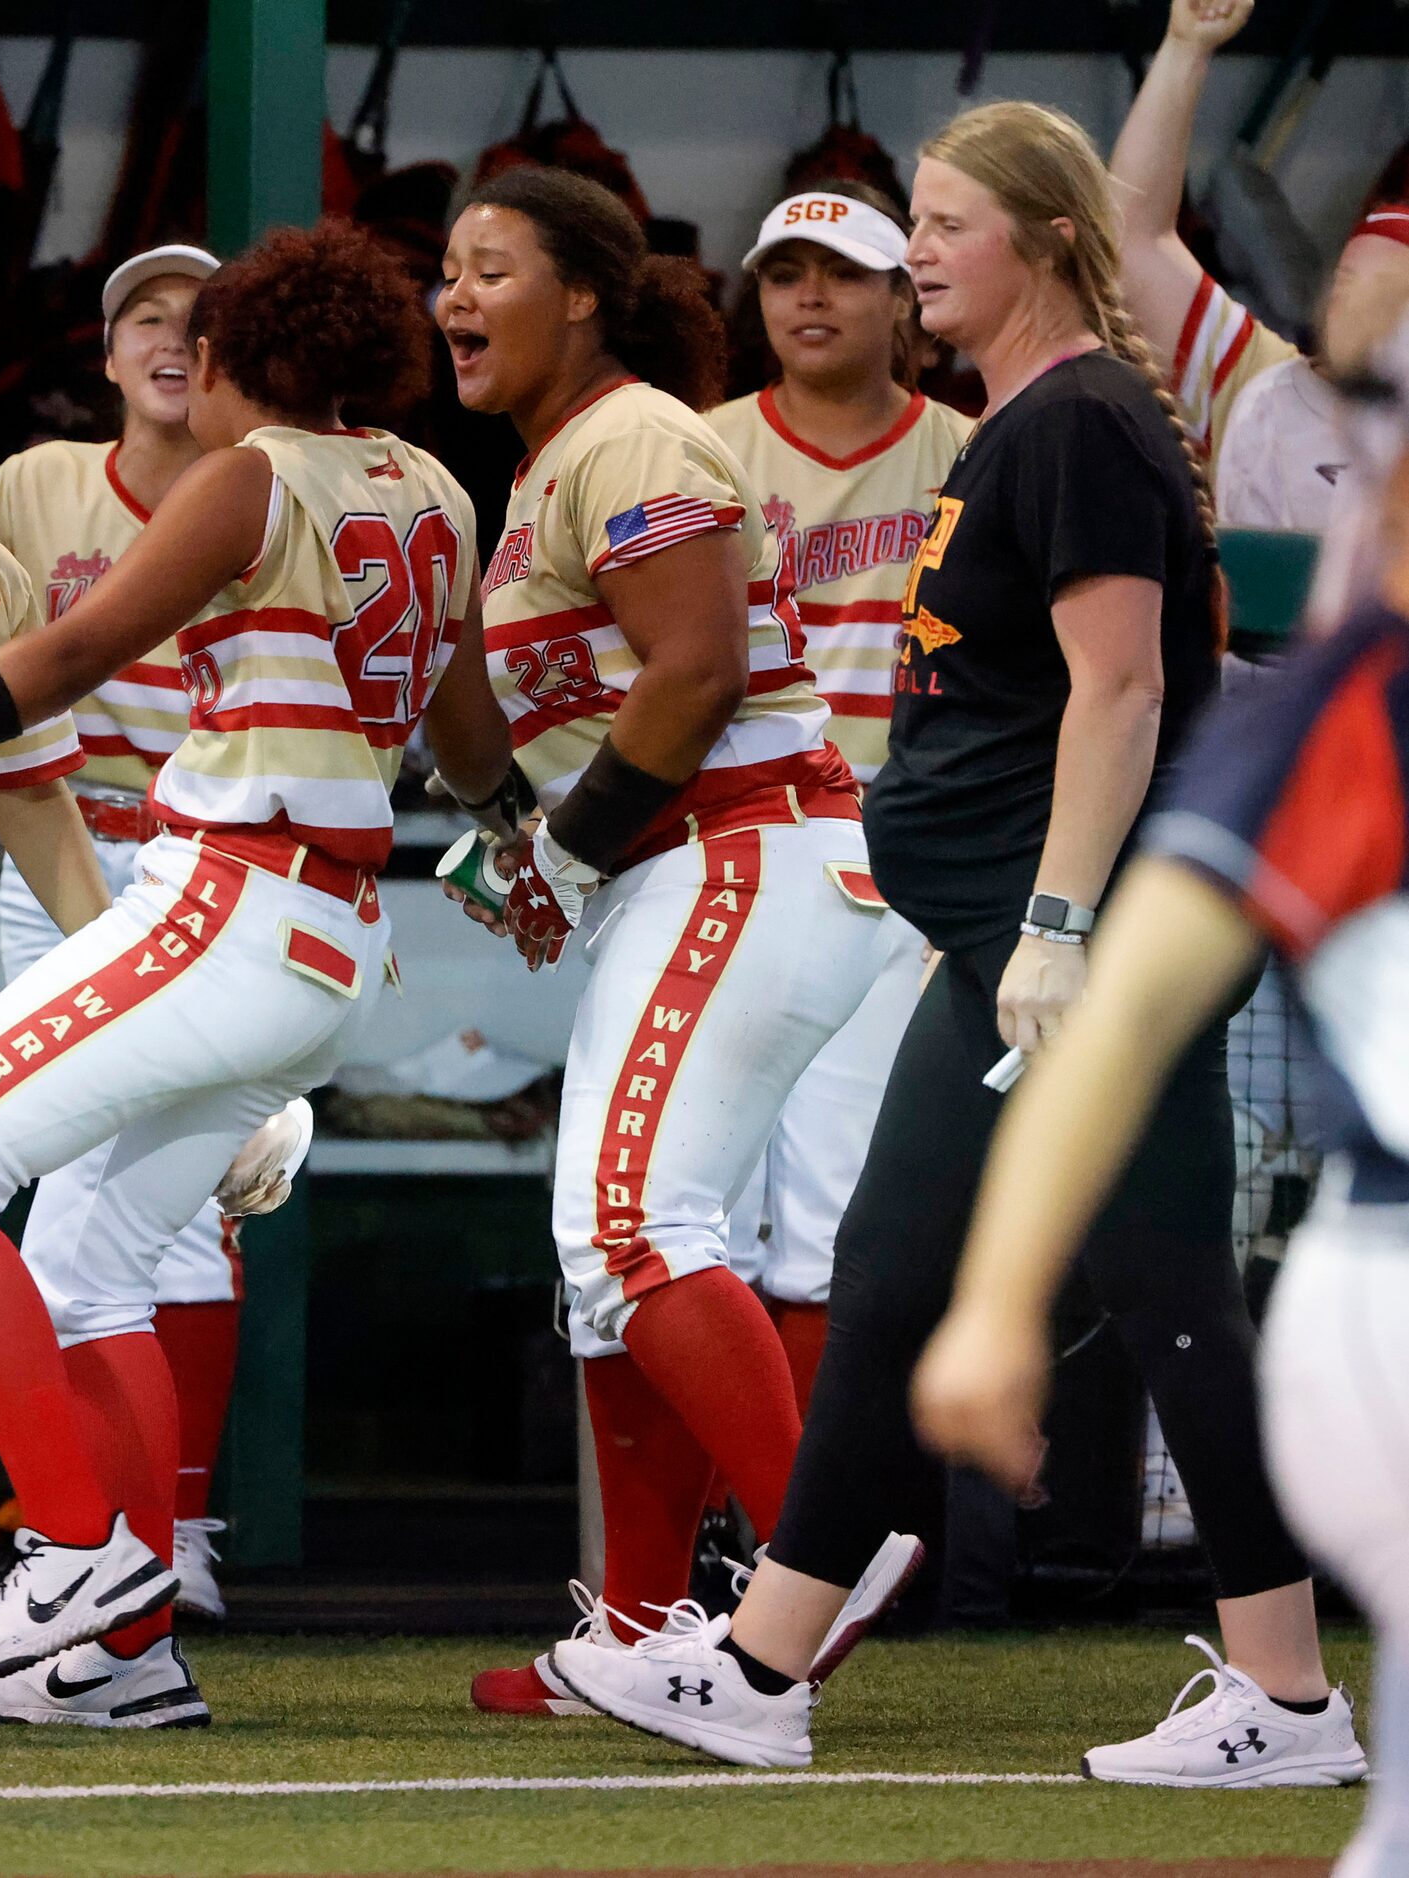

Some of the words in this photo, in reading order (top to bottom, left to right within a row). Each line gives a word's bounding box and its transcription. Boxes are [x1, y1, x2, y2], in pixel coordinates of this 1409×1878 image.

[785, 200, 848, 225] SGP
[330, 505, 461, 725] 20
[504, 633, 605, 709] 23
[133, 879, 219, 978] LADY
[687, 860, 745, 974] LADY
